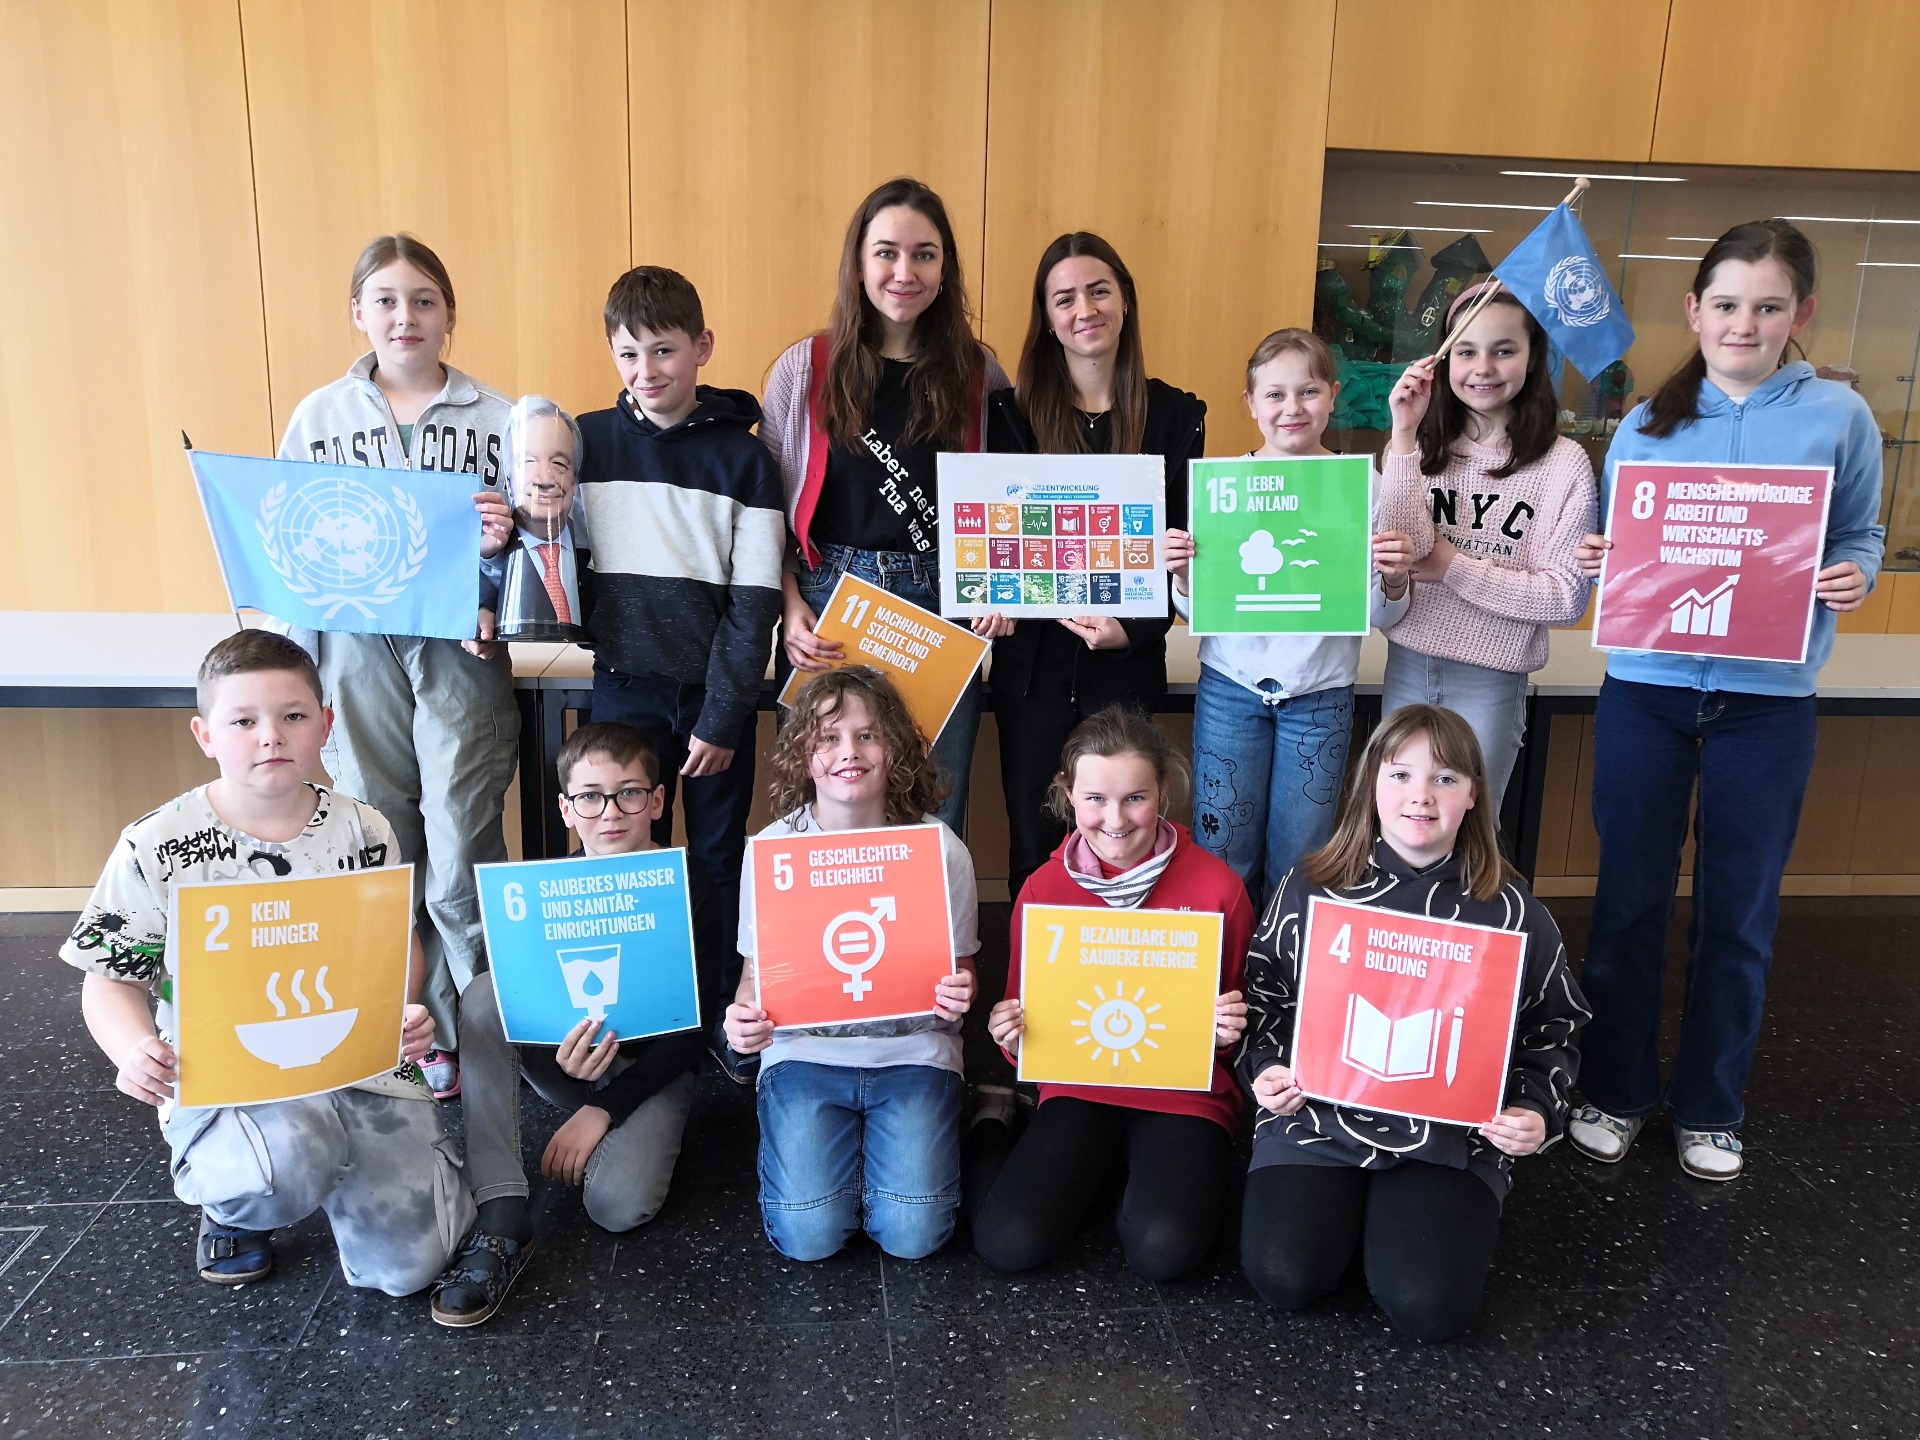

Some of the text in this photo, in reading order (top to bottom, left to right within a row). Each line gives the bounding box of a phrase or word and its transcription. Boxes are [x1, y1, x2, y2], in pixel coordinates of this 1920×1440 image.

[420, 423, 508, 490] COAS
[861, 428, 909, 481] Laber
[1046, 484, 1100, 492] ENTWICKLUNG
[1206, 477, 1238, 513] 15
[1246, 475, 1285, 492] LEBEN
[1666, 482, 1815, 505] MENSCHENWÜRDIGE
[879, 478, 931, 552] Tua was
[1246, 495, 1299, 512] AN LAND
[1430, 487, 1535, 541] NYC
[1631, 481, 1656, 520] 8
[1664, 504, 1748, 524] ARBEIT UND
[1443, 533, 1513, 556] NHATTAN
[1662, 525, 1768, 547] WIRTSCHAFTS-
[1660, 546, 1743, 567] WACHSTUM
[841, 594, 871, 629] 11
[866, 621, 930, 660] STÄDTE UND
[874, 606, 946, 648] NACHHALTIGE
[858, 637, 919, 674] GEMEINDEN
[179, 839, 237, 869] MAKE
[808, 844, 913, 867] GESCHLECHTER-
[539, 867, 675, 898] SAUBERES WASSER
[773, 853, 794, 891] 5
[809, 865, 885, 888] GLEICHHEIT
[251, 900, 291, 922] KEIN
[503, 882, 527, 922] 6
[541, 893, 639, 919] UND SANITÄR-
[204, 904, 230, 951] 2
[251, 922, 319, 948] HUNGER
[544, 912, 656, 941] EINRICHTUNGEN
[1080, 926, 1199, 948] BEZAHLBARE UND
[1046, 924, 1065, 964] 7
[1079, 948, 1199, 969] SAUBERE ENERGIE
[1328, 923, 1352, 964] 4
[1367, 927, 1474, 964] HOCHWERTIGE
[1364, 950, 1428, 979] BILDUNG
